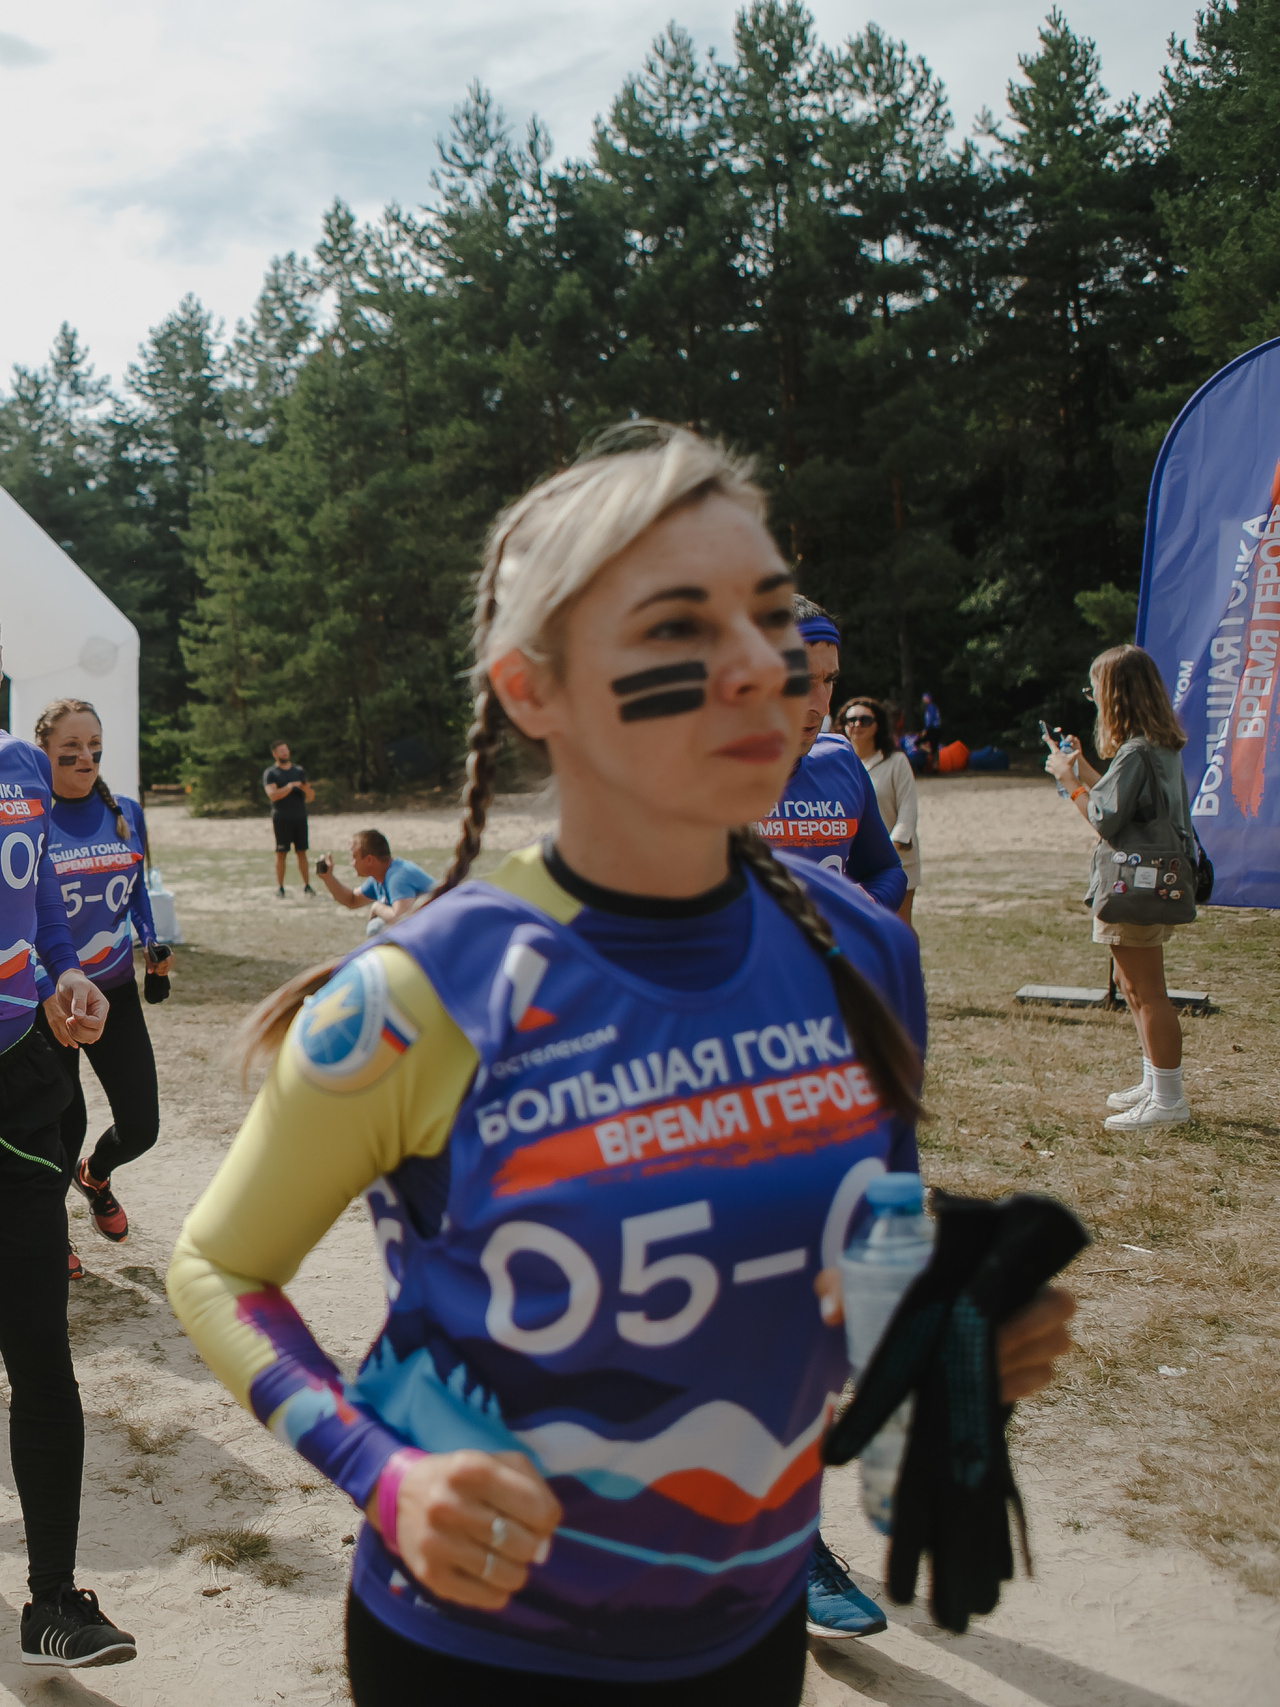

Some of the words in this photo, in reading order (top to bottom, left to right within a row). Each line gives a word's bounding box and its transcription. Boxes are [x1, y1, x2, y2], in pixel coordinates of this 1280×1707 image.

[1251, 504, 1280, 621] ГЕРОЕ
[1235, 629, 1280, 739] ВРЕМЯ
[1190, 635, 1242, 817] БОЛЬШАЯ
[784, 801, 846, 818] ГОНКА
[788, 821, 848, 836] ГЕРОЕВ
[49, 846, 90, 863] ЬШАЯ
[90, 843, 131, 855] ГОНКА
[54, 858, 94, 874] ВРЕМЯ
[60, 872, 138, 918] 5-0
[474, 1024, 618, 1094] остелеком
[476, 1037, 729, 1145] БОЛЬШАЯ
[733, 1016, 853, 1078] ГОНК
[594, 1084, 750, 1165] ВРЕМЯ
[752, 1065, 878, 1128] ГЕРОЕ
